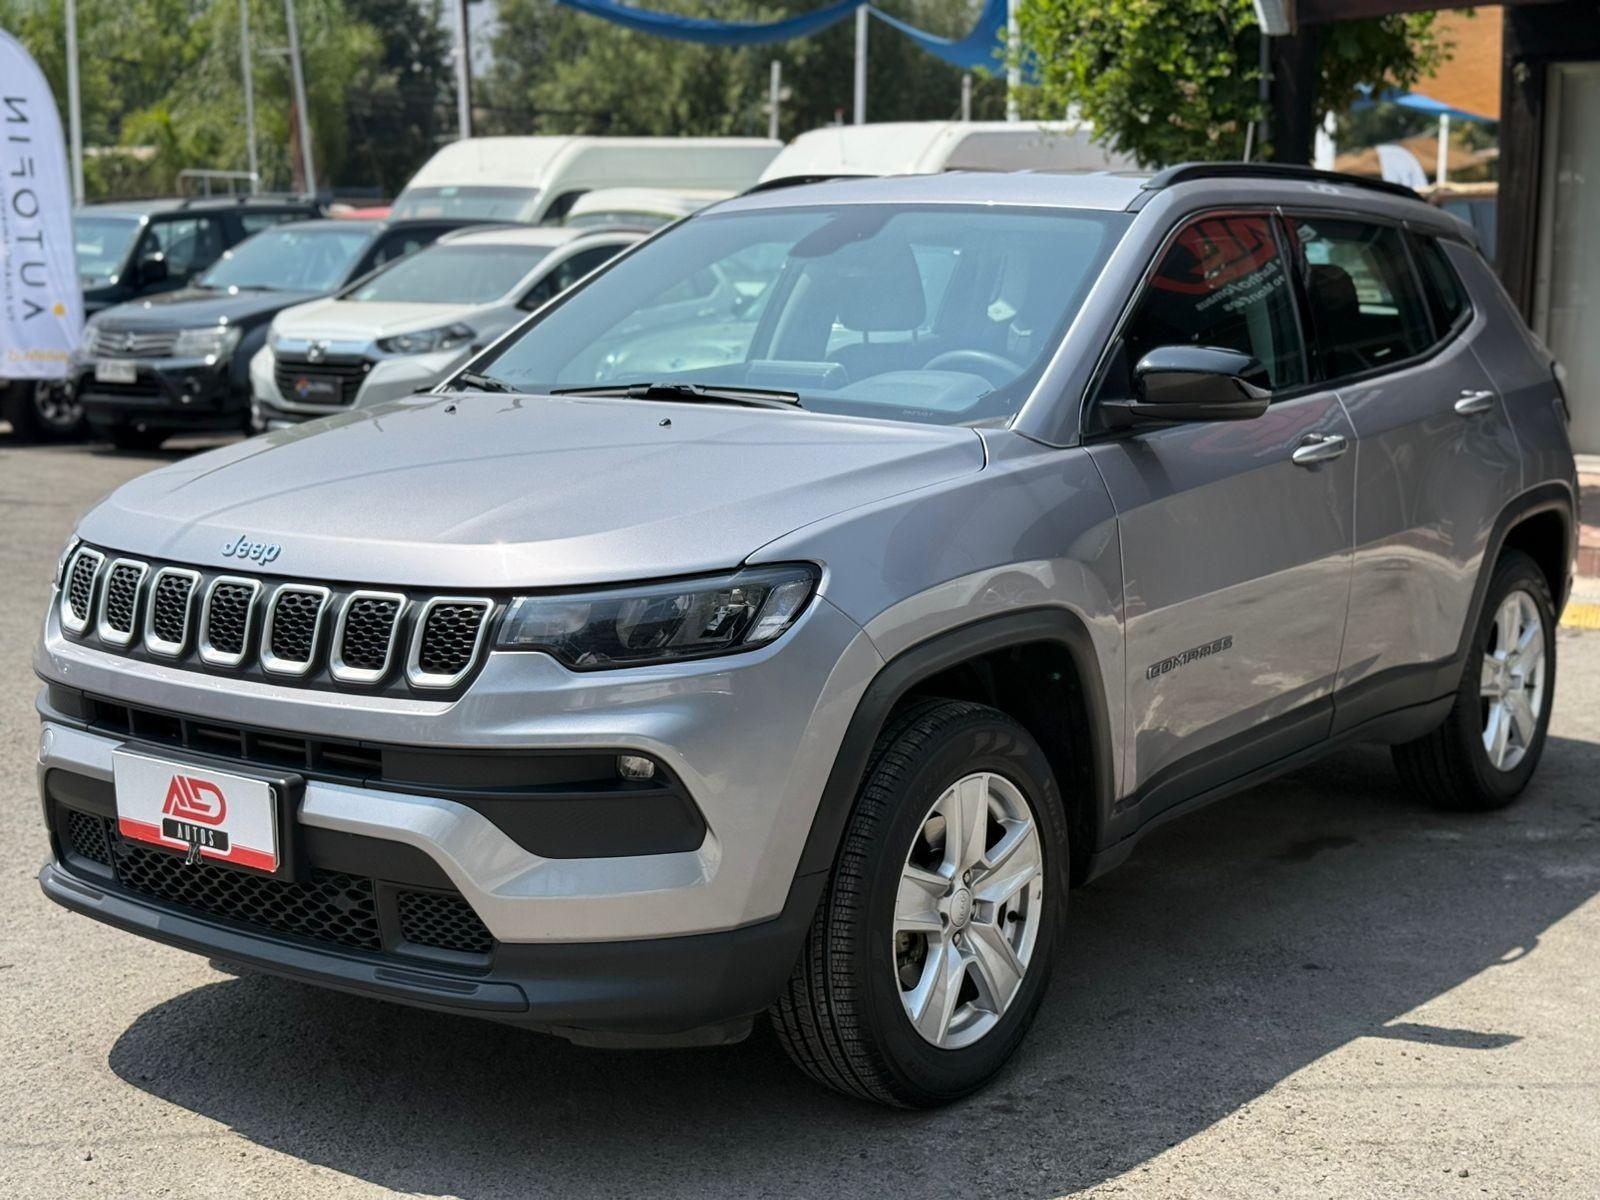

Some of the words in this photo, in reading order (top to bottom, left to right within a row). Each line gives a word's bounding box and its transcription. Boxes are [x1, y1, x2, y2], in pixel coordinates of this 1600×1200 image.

[222, 534, 281, 566] Jeep
[1146, 635, 1233, 680] COMPASS
[177, 823, 214, 847] AUTOS
